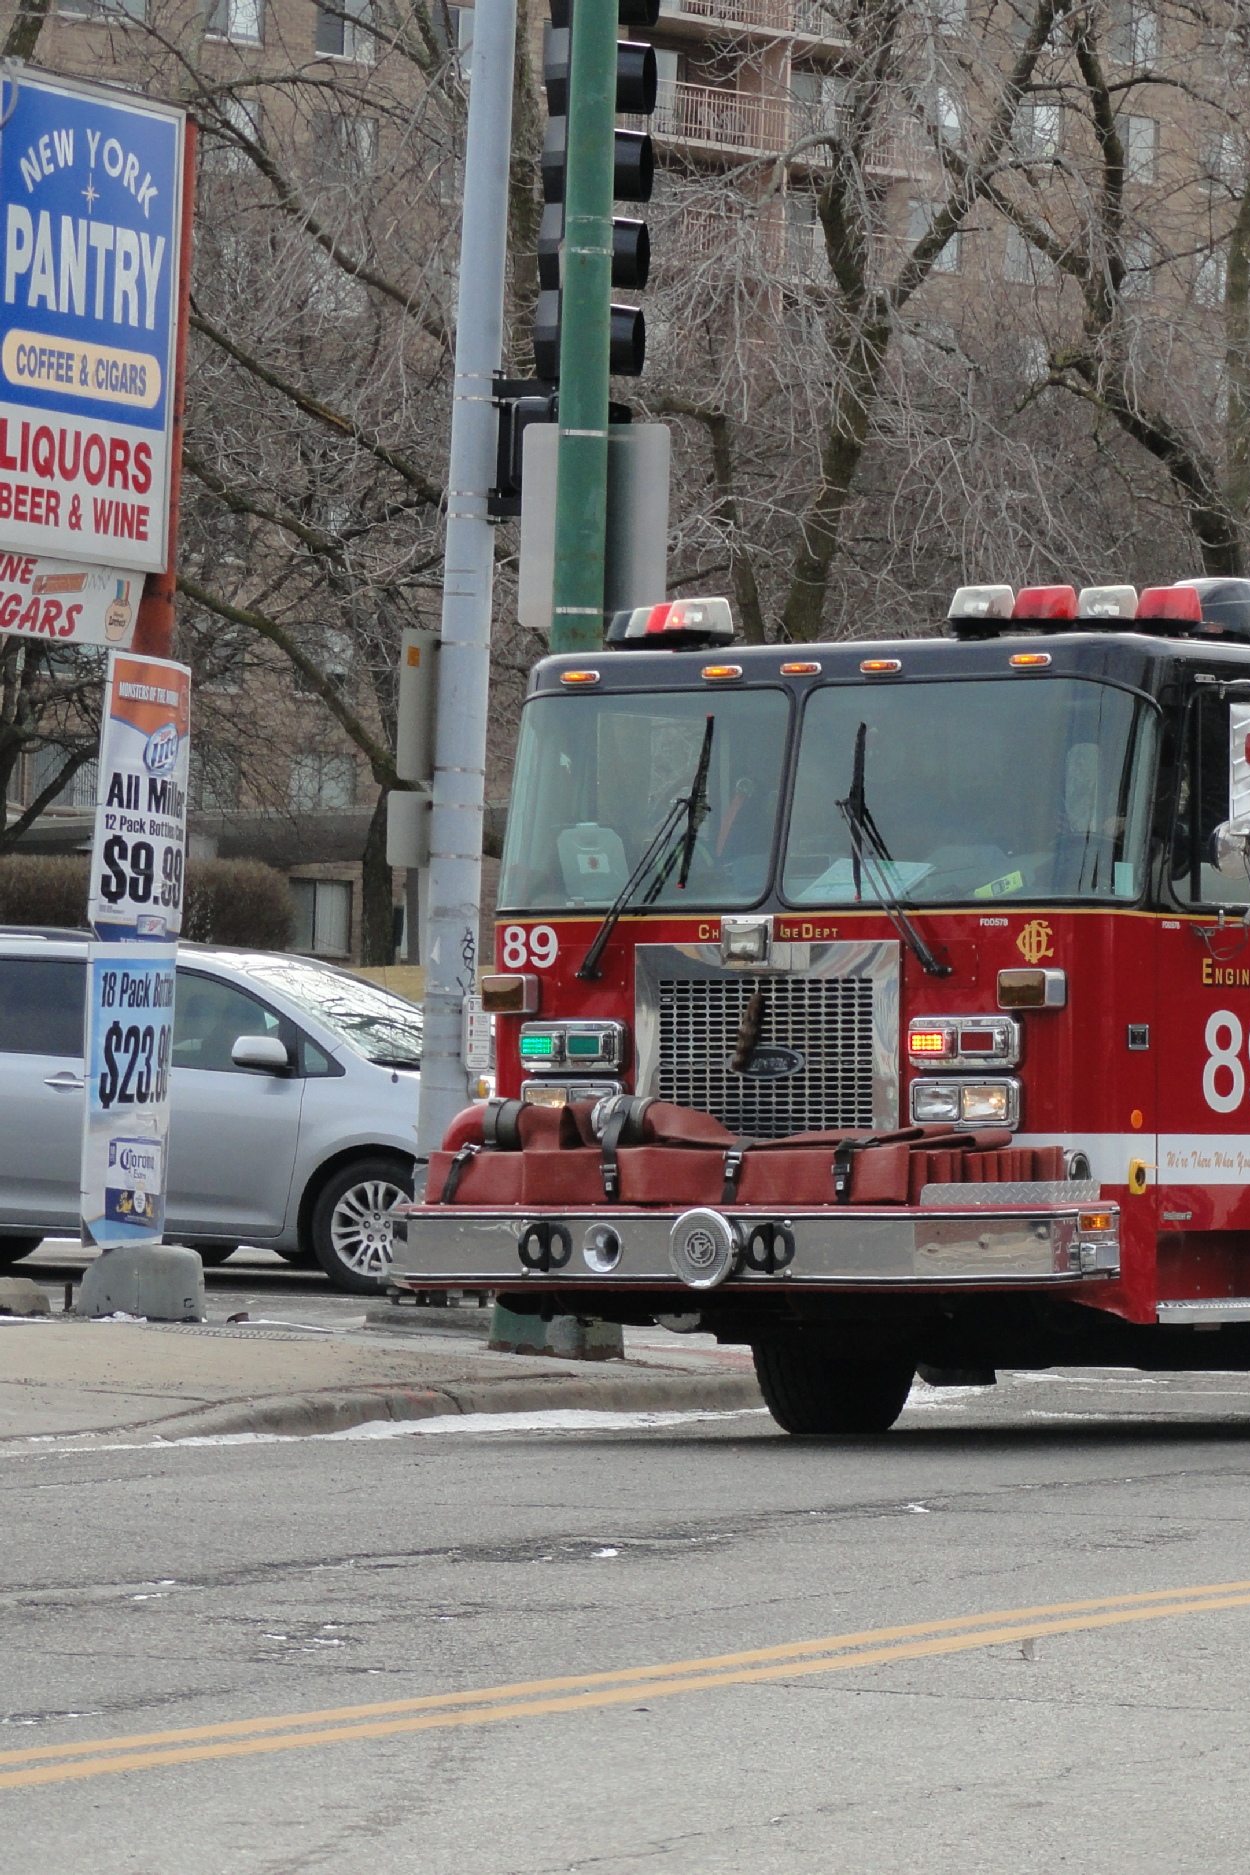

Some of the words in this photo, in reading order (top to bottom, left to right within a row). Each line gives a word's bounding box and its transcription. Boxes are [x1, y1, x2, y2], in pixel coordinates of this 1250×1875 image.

[20, 128, 74, 193] NEW
[86, 128, 159, 219] YORK
[5, 203, 166, 331] PANTRY
[16, 344, 75, 386] COFFEE
[80, 358, 89, 387] &
[96, 358, 147, 397] CIGARS
[0, 417, 153, 495] LIQUORS
[0, 482, 61, 527] BEER
[68, 494, 83, 531] &
[93, 497, 150, 541] WINE
[105, 772, 140, 811] All
[147, 777, 185, 820] Miller
[105, 813, 117, 831] 12
[120, 815, 146, 835] Pack
[100, 834, 183, 910] $9.99
[503, 925, 559, 968] 89
[101, 971, 116, 1009] 18
[119, 972, 151, 1008] Pack
[120, 1147, 155, 1173] Corona
